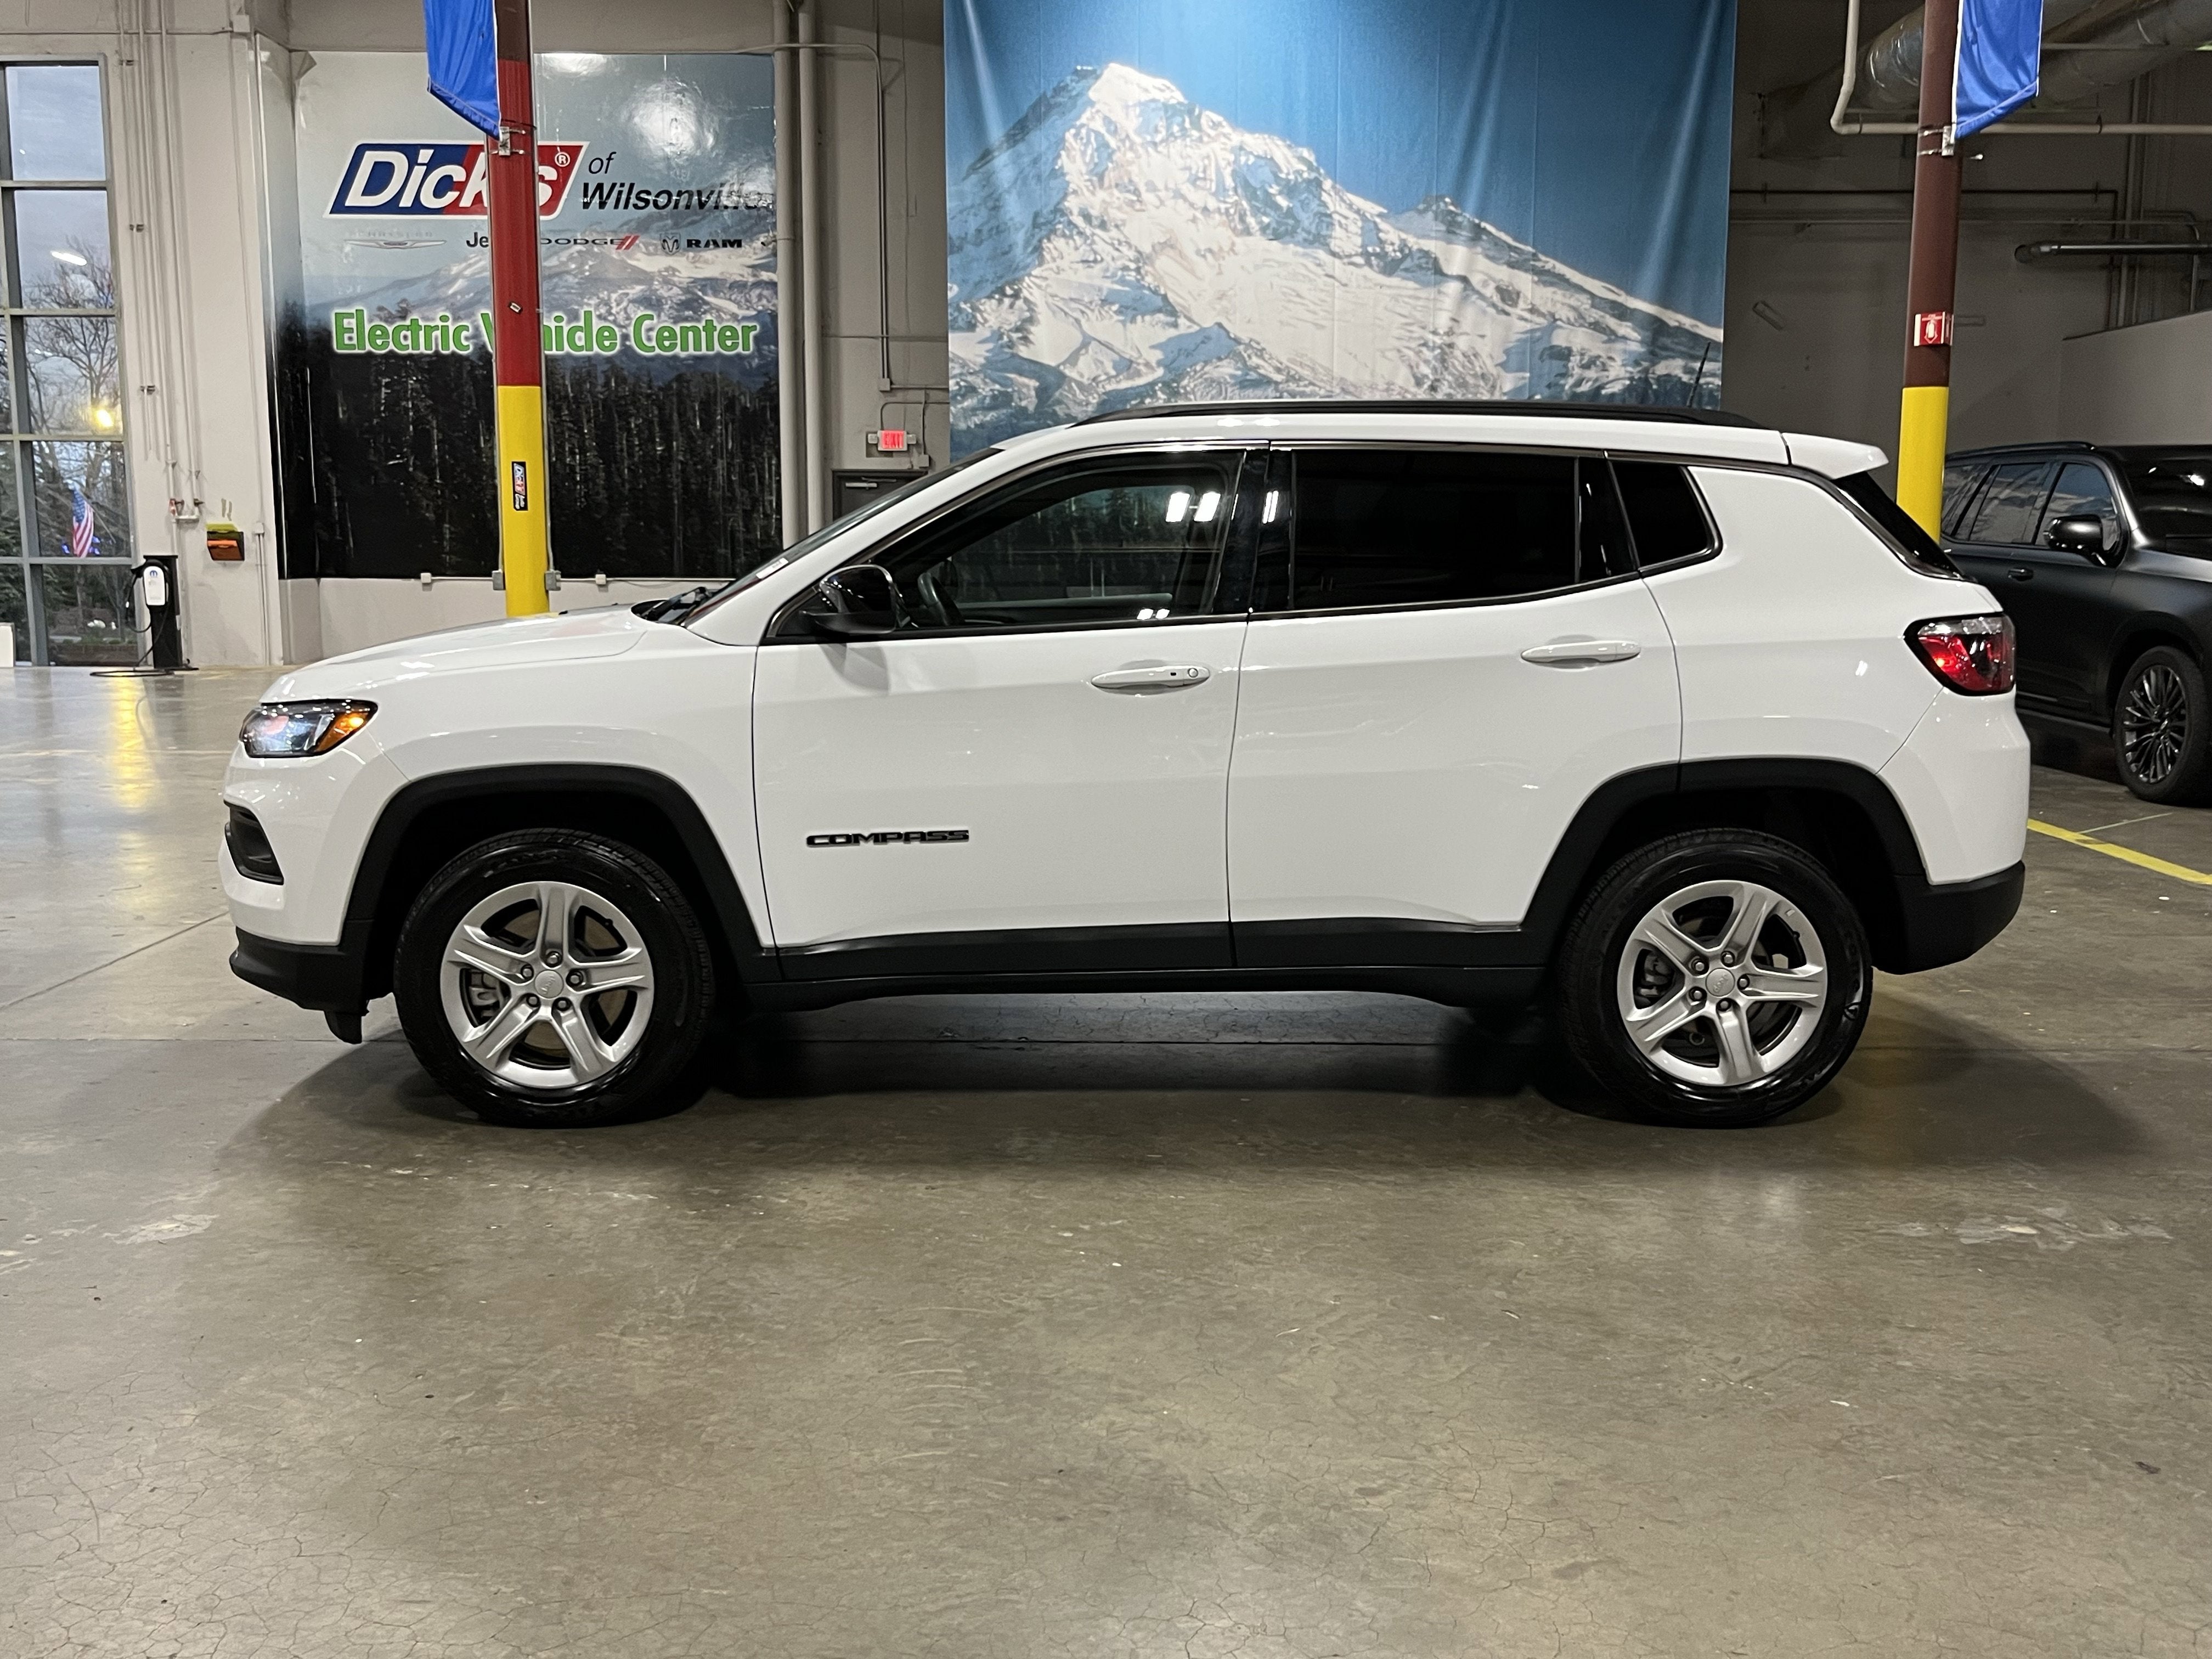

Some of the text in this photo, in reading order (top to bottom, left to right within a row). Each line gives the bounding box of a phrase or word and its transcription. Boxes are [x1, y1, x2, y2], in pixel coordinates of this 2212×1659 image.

[588, 152, 616, 174] of
[582, 183, 759, 210] Wilsonvi
[466, 232, 489, 247] Je
[687, 239, 742, 248] RAM
[335, 309, 757, 352] Electric Vicle Center
[806, 830, 969, 848] COMPASS
